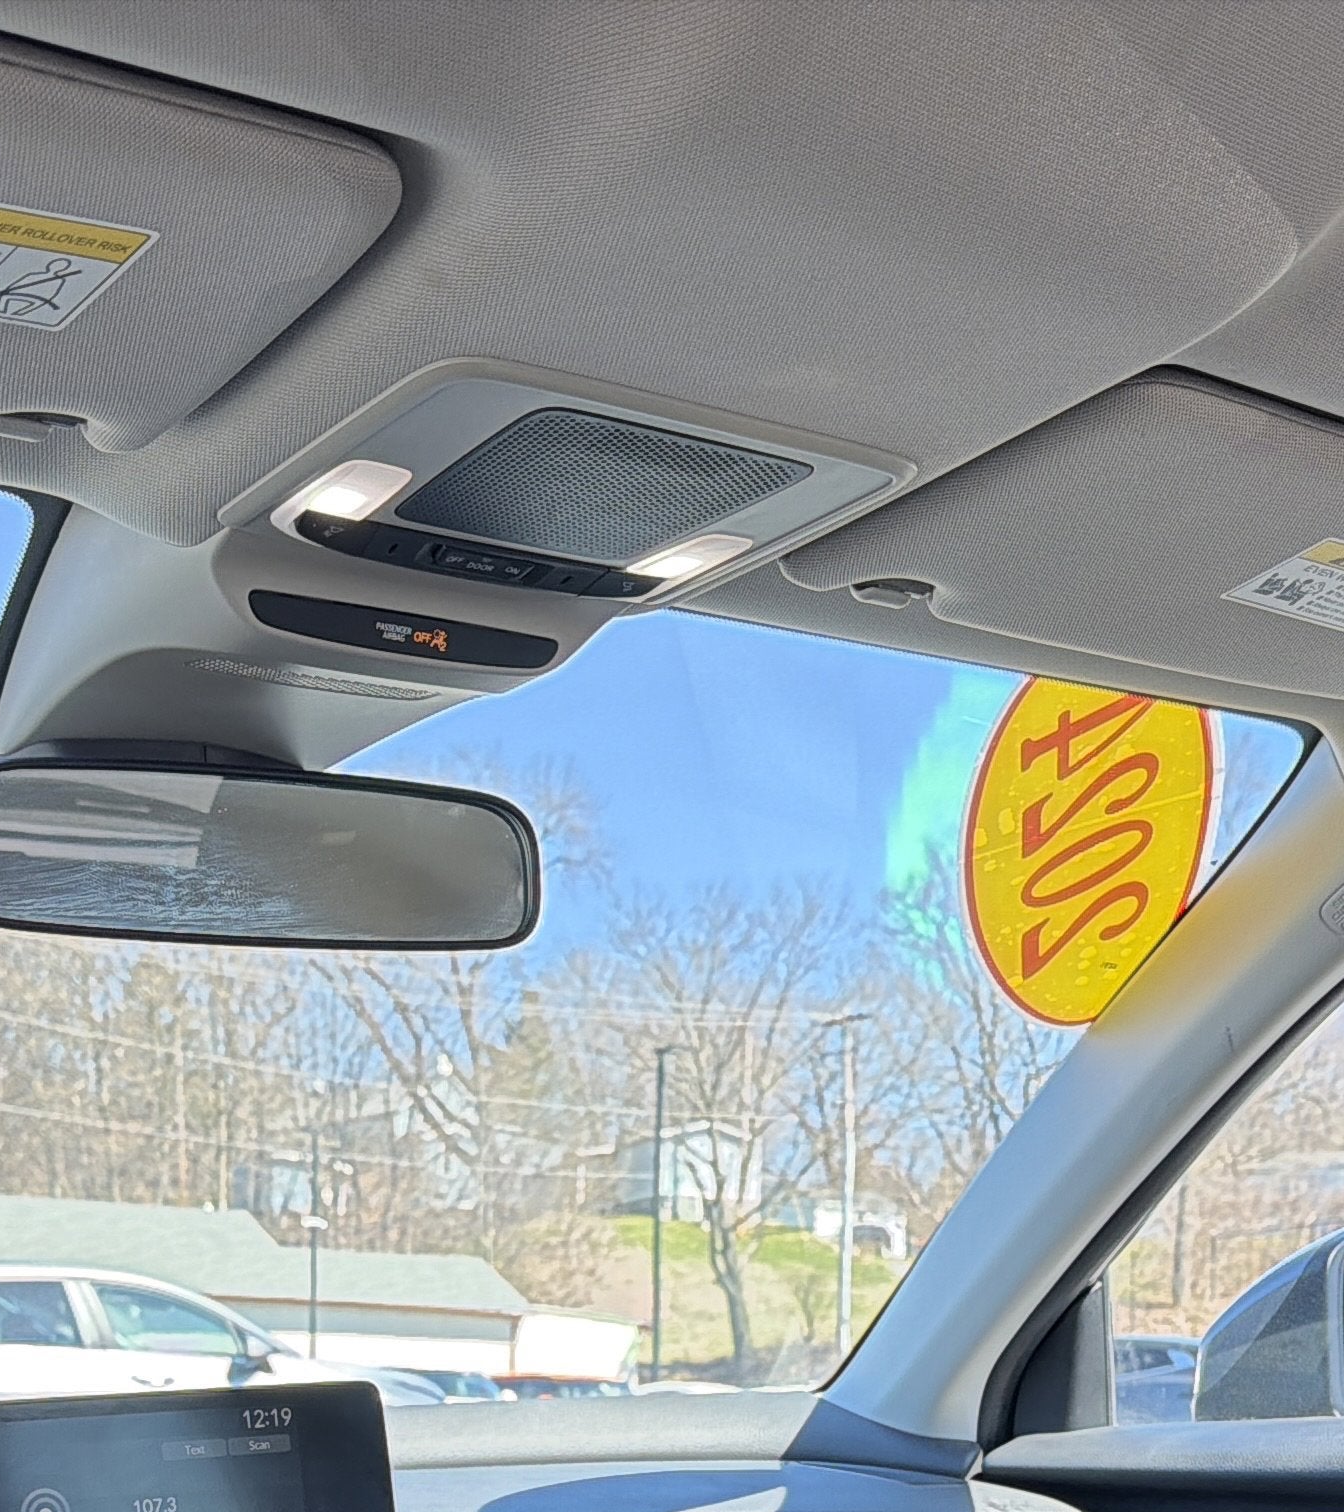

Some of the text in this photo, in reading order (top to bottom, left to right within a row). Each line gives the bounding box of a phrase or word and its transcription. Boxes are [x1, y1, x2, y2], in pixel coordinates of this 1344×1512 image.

[20, 228, 98, 248] ROLLOVER
[96, 240, 132, 254] RISK
[466, 562, 495, 572] DOOR
[1303, 564, 1339, 579] EVEN
[376, 622, 413, 635] PASSENGER
[413, 631, 432, 643] OFF
[243, 1407, 292, 1429] 12:19
[185, 1444, 205, 1456] Text
[249, 1440, 271, 1451] Scan
